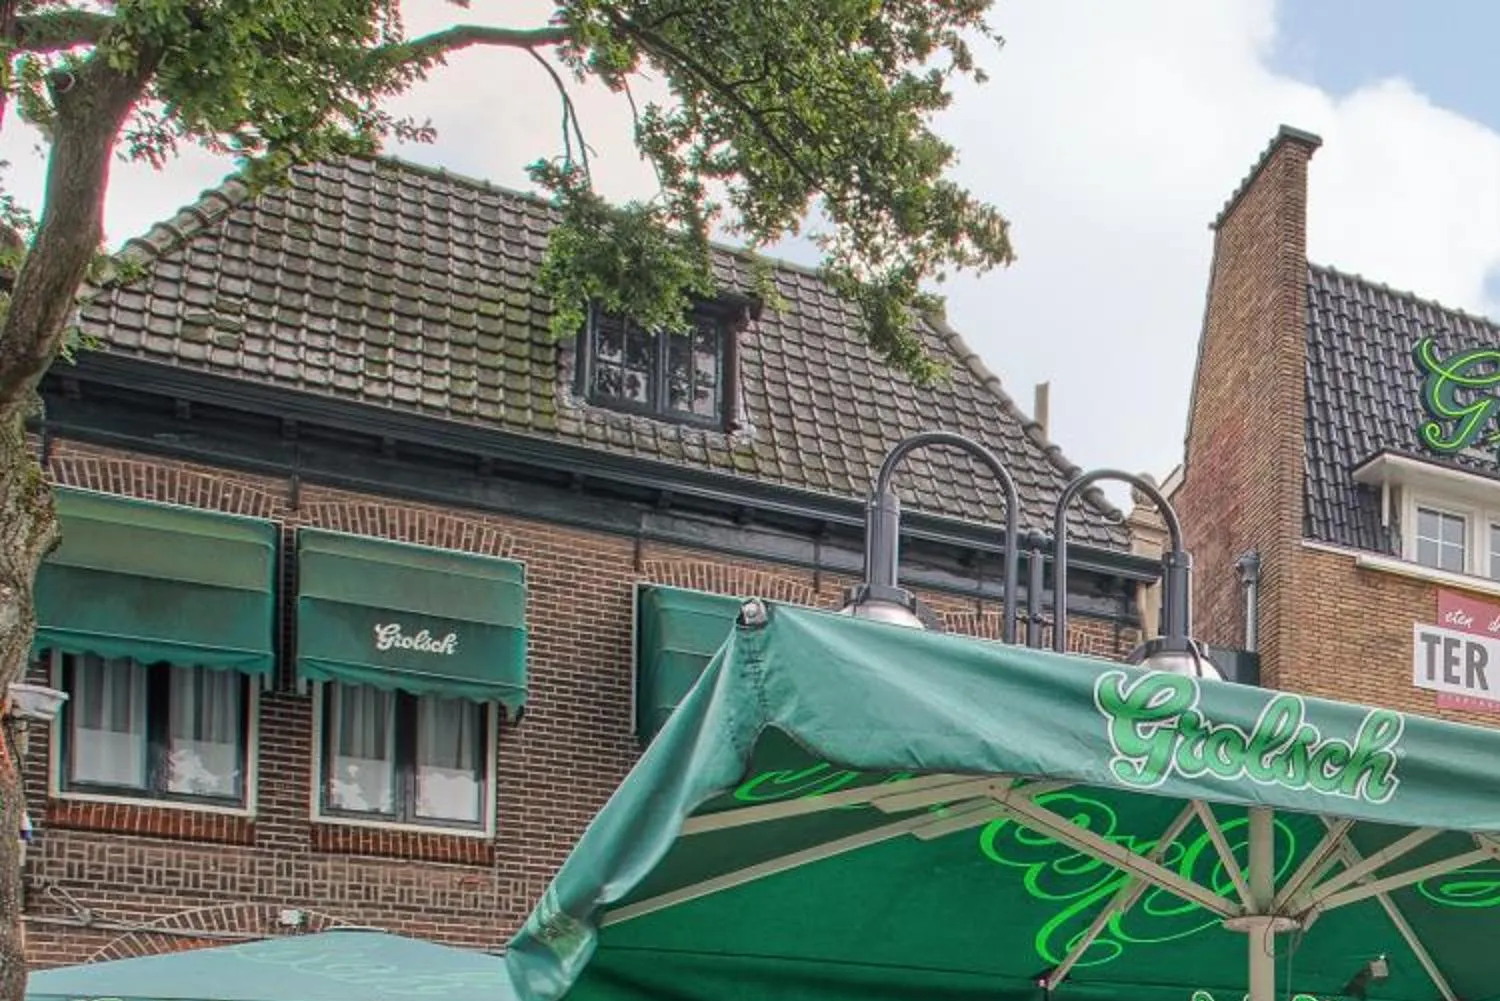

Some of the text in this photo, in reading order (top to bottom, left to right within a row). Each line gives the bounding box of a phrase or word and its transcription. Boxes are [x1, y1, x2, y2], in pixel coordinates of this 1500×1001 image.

[374, 623, 459, 655] Grolsch
[1445, 609, 1474, 629] eten
[1420, 632, 1488, 690] TER
[1093, 670, 1406, 804] Grolsch
